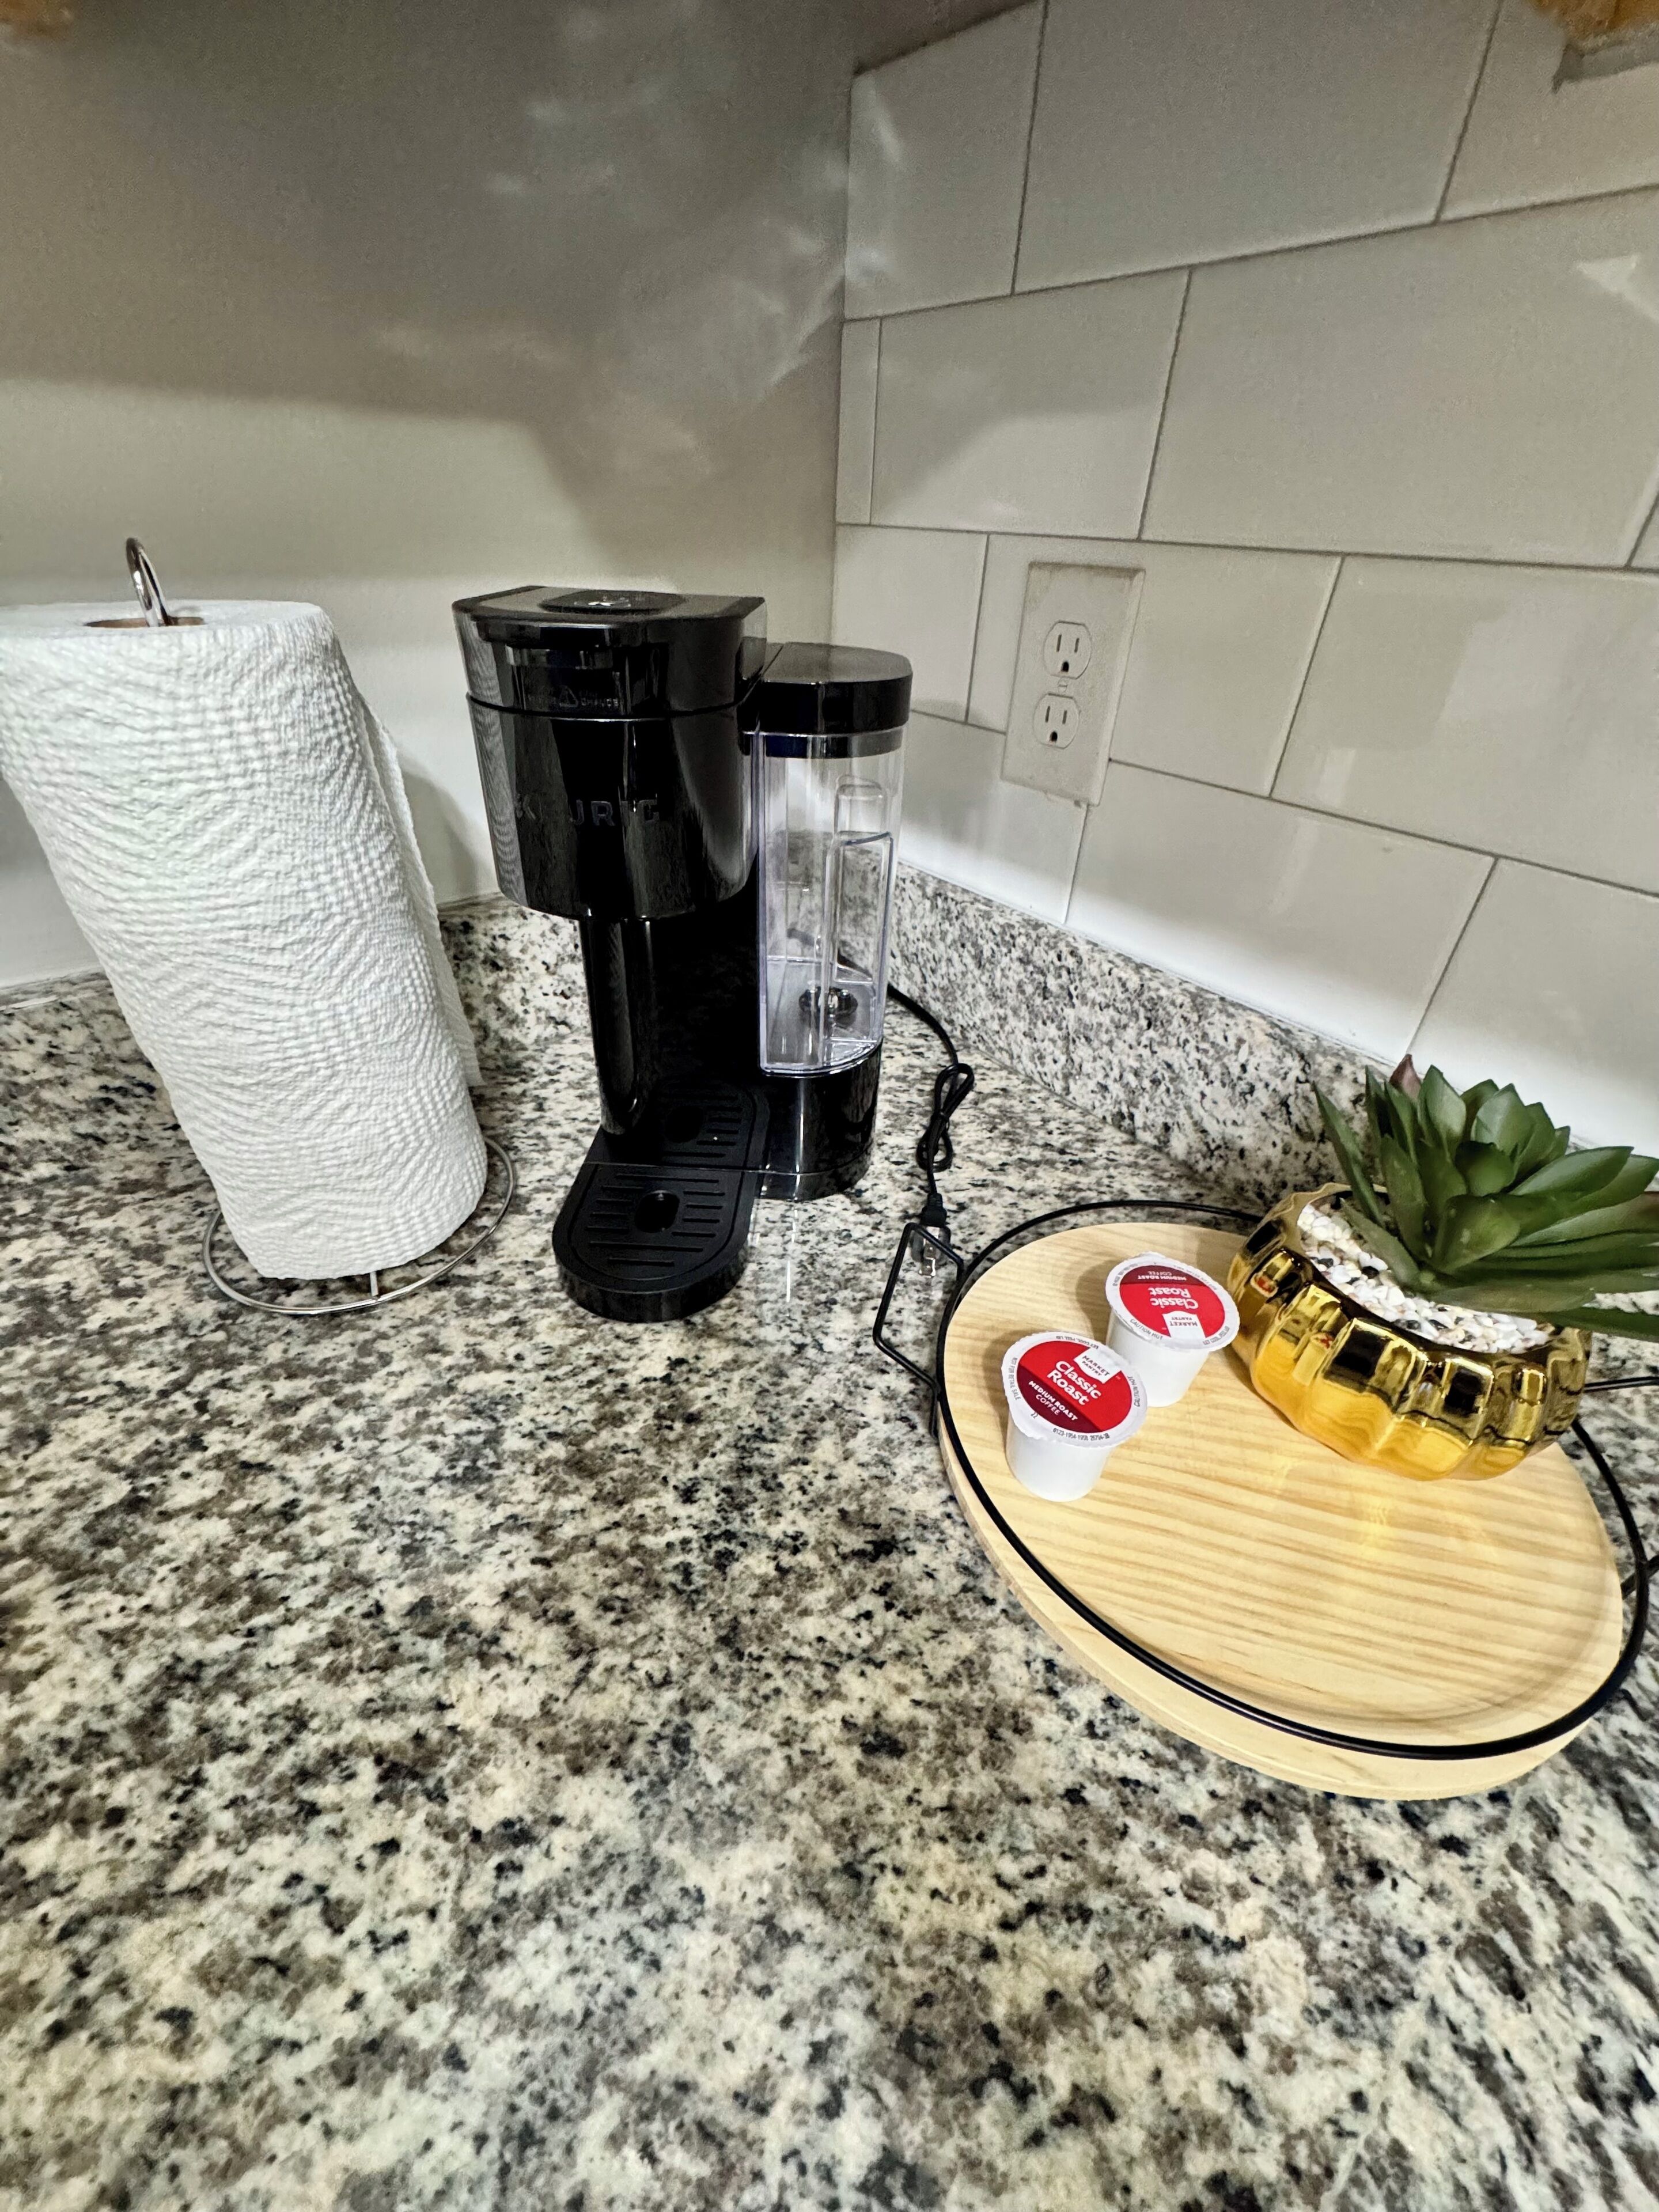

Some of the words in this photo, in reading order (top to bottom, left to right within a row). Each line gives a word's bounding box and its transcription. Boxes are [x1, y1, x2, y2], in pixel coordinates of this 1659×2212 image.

[1147, 1287, 1191, 1298] Roast
[1150, 1298, 1199, 1309] Classic
[1130, 1319, 1152, 1335] CAUTION
[1152, 1332, 1164, 1340] HOT
[1081, 1355, 1110, 1376] MARKET
[1081, 1361, 1103, 1376] PANTRY
[1047, 1369, 1090, 1406] Roast
[1055, 1361, 1102, 1399] Classic
[1127, 1375, 1138, 1387] HOT
[1028, 1380, 1056, 1403] MEDIUM
[1054, 1400, 1078, 1421] ROAST
[1036, 1394, 1060, 1415] COFFEE
